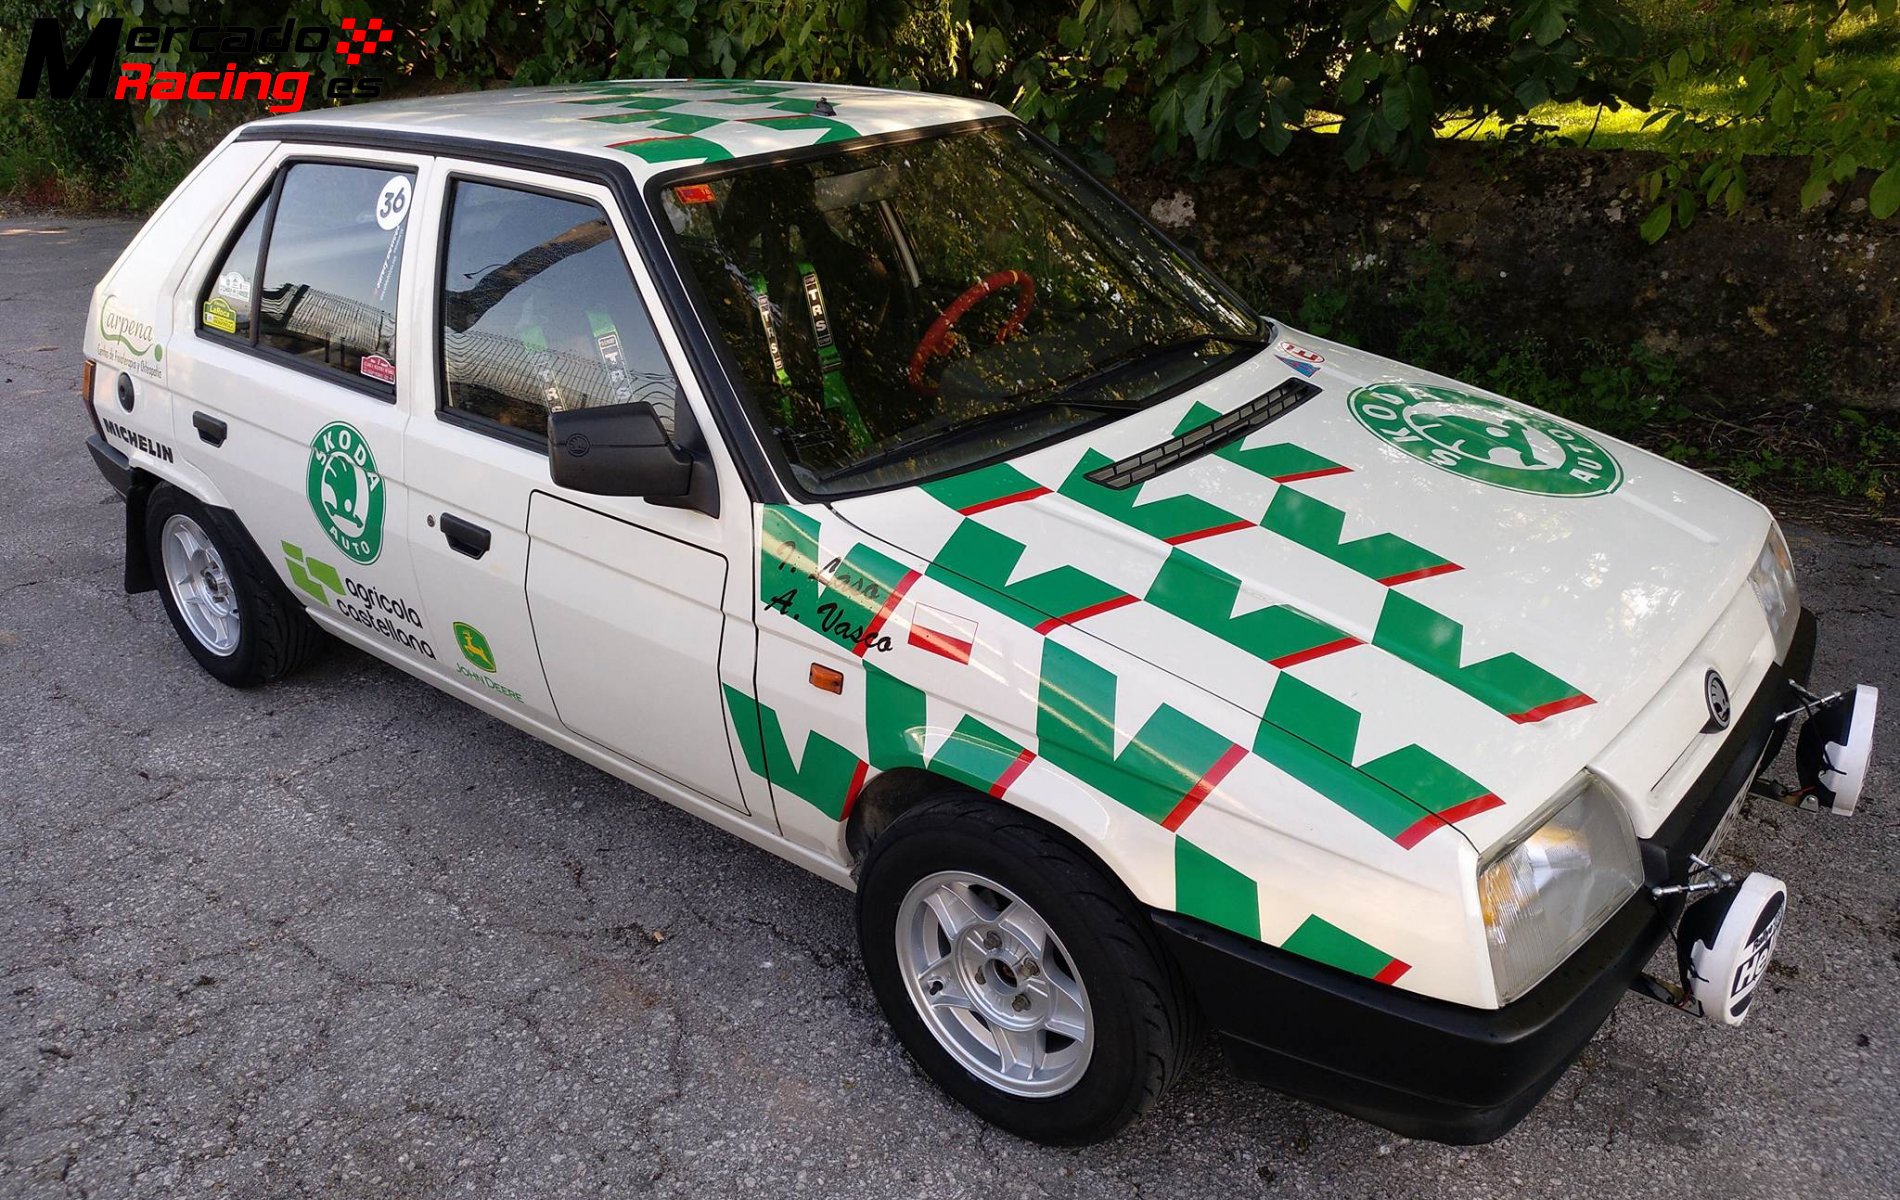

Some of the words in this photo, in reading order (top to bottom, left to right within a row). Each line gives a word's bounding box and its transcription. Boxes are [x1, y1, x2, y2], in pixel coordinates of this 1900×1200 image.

[380, 187, 406, 218] 36
[102, 417, 174, 464] MICHELIN
[1547, 427, 1604, 485] AUTO
[330, 525, 371, 556] AUTO
[336, 598, 437, 661] castellana
[763, 588, 800, 621] A.
[816, 602, 893, 653] Vasco
[456, 662, 486, 685] JOHN
[484, 676, 525, 704] DEERE
